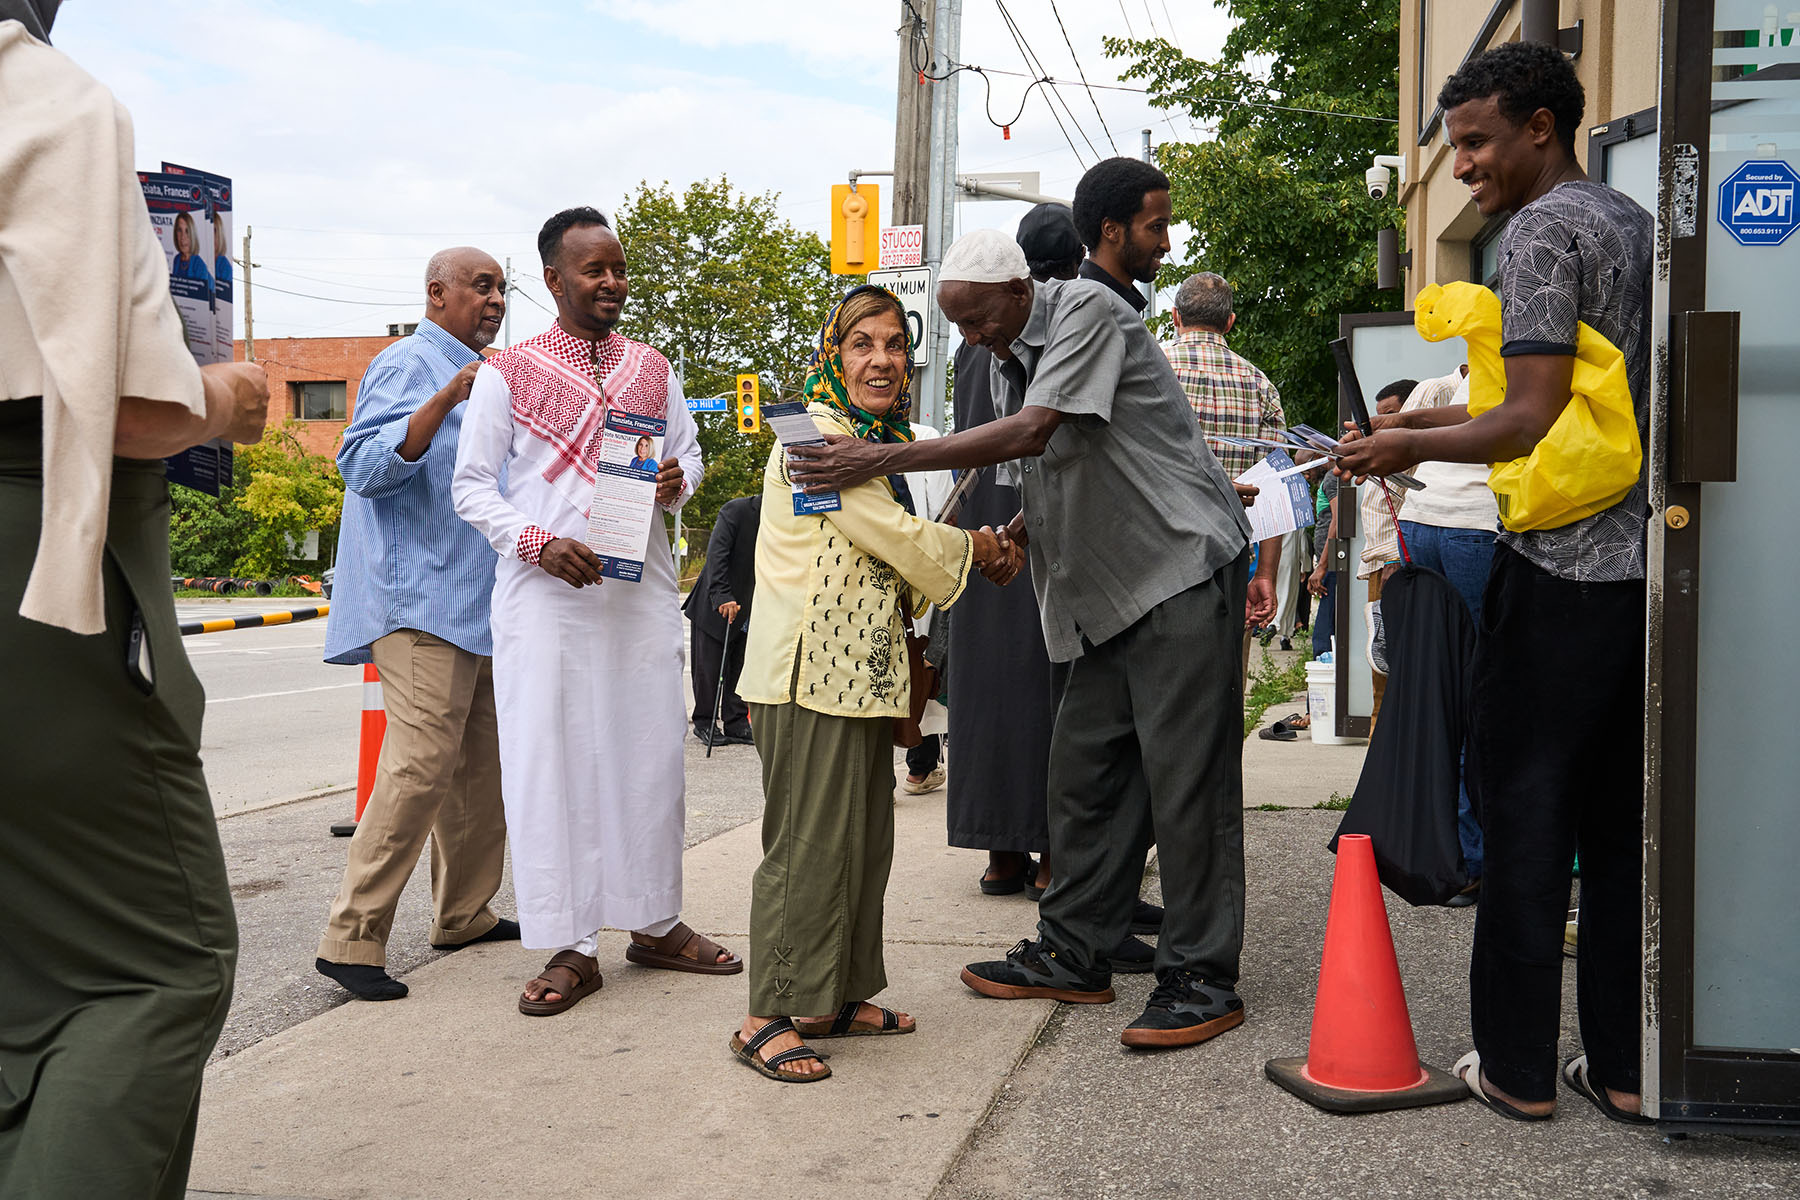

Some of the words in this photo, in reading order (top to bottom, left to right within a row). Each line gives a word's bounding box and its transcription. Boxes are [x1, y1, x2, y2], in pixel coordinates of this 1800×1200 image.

[143, 184, 164, 197] ziata,
[164, 185, 191, 198] Frances
[1733, 189, 1794, 217] ADT
[881, 230, 922, 250] STUCCO
[881, 253, 921, 266] 437-237-8989
[883, 280, 926, 296] XIMUM
[700, 400, 714, 409] Hill
